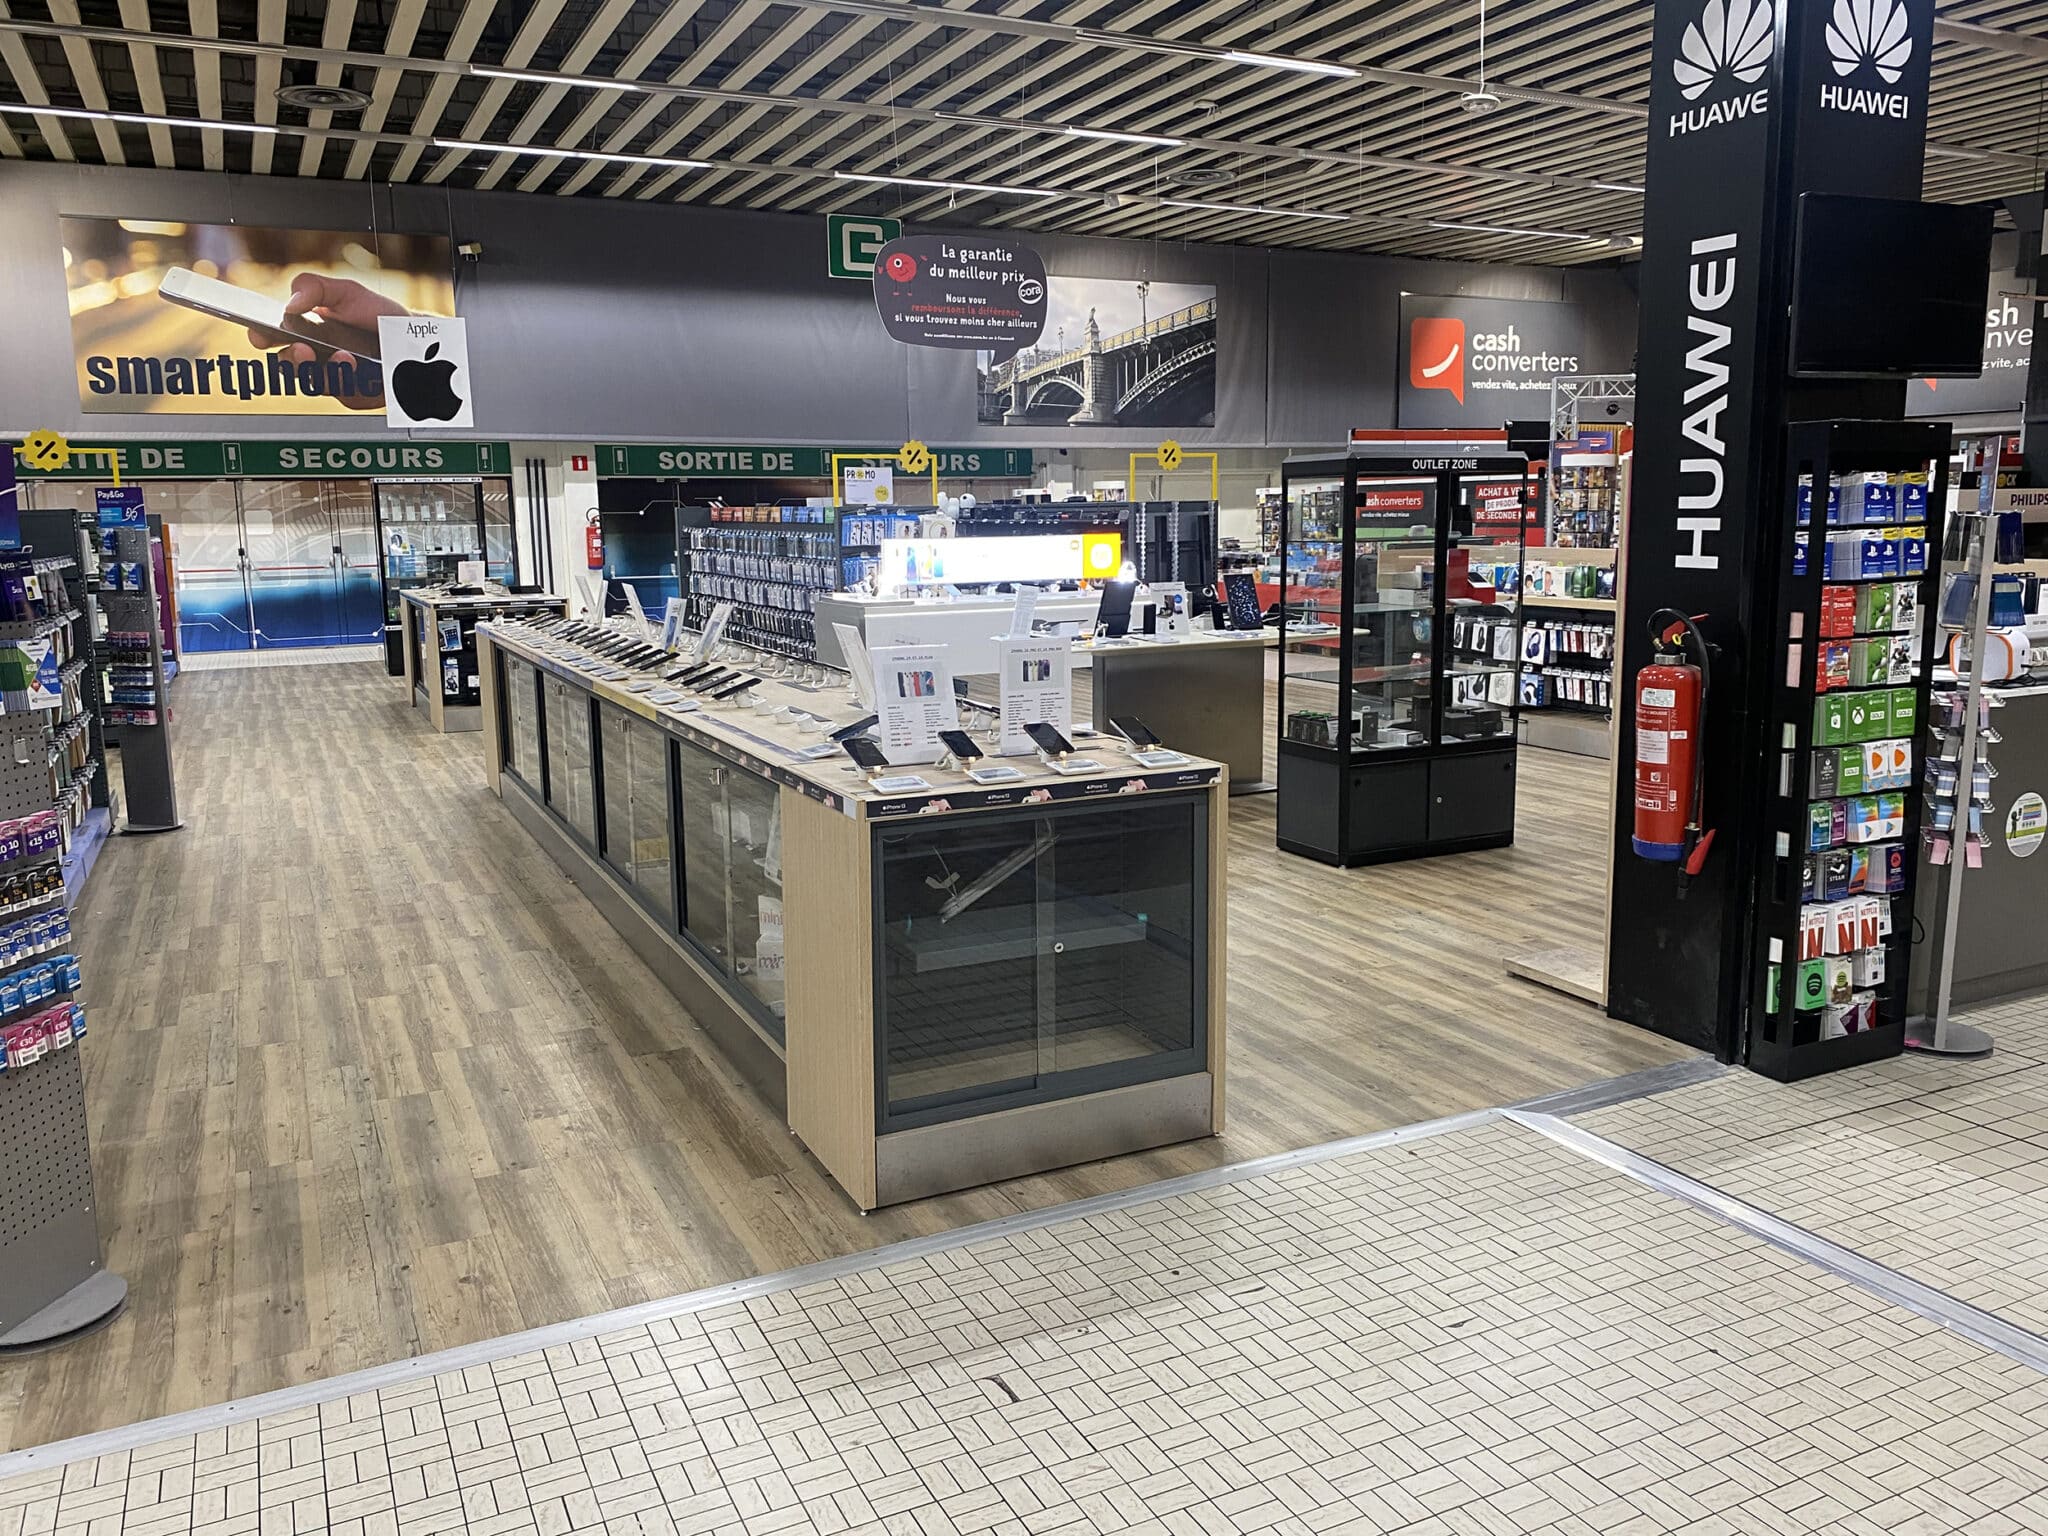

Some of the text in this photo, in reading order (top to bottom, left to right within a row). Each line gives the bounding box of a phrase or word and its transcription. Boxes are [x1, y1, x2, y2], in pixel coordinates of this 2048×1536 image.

[1820, 84, 1909, 119] HUAWEI
[1669, 88, 1769, 137] HUAWE
[942, 244, 1013, 264] La garantie
[929, 263, 1025, 285] du meilleur prix
[946, 293, 966, 303] Nous
[1020, 286, 1041, 297] cora
[1985, 297, 2019, 329] sh
[894, 313, 1038, 329] si vous trouvez moins cher ailleurs
[406, 321, 439, 338] Apple
[1472, 325, 1520, 352] cash
[1472, 351, 1578, 372] converters
[1990, 357, 2014, 369] vite,
[1472, 378, 1501, 390] vendez
[1502, 380, 1519, 391] vite,
[1675, 233, 1737, 569] HUAWEI
[141, 448, 184, 469] DE
[280, 448, 444, 469] SECOURS
[658, 451, 794, 471] SORTIE DE
[1412, 459, 1478, 470] OUTLET ZONE
[97, 490, 124, 500] Pay&Go
[1478, 486, 1535, 497] ACHAT & VETE
[1366, 494, 1421, 506] ash converters
[2010, 493, 2048, 506] PHILIPS
[1476, 511, 1485, 520] DE
[1486, 511, 1518, 520] SECONDE
[1837, 911, 1854, 920] NETFLIX
[1861, 907, 1877, 915] NETFLIX
[1809, 916, 1825, 925] NETFLIX
